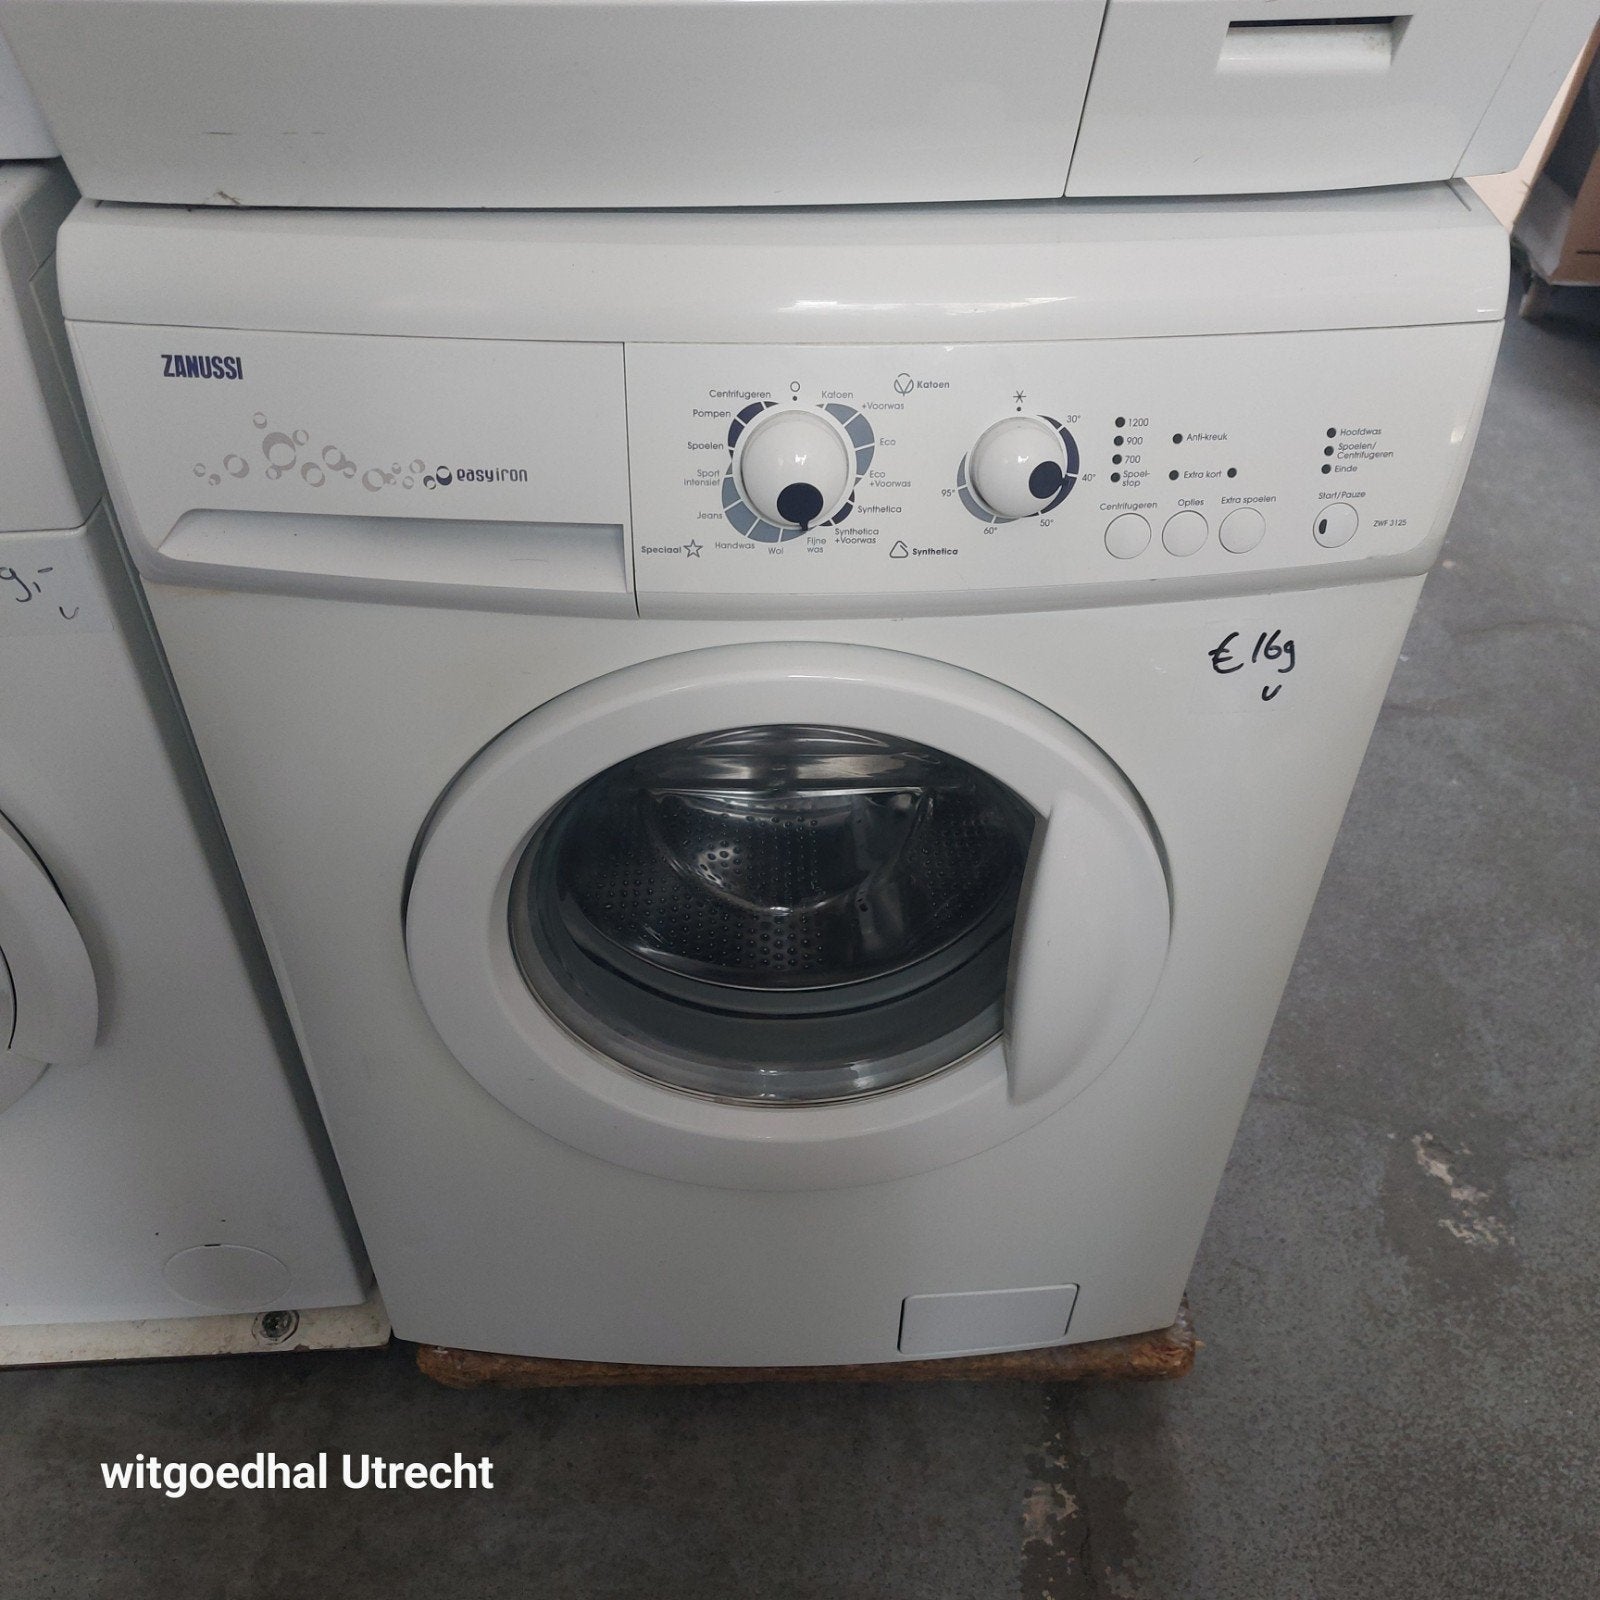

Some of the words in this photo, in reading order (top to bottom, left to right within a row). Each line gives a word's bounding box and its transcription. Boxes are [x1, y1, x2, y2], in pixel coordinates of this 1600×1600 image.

[161, 354, 244, 380] ZANUSSI
[917, 380, 950, 390] Katoen
[709, 390, 771, 400] Centrifugeren
[821, 391, 854, 399] Katoen
[862, 402, 905, 411] +Voorwas
[693, 410, 732, 420] Pompen
[1128, 418, 1149, 427] 1200
[1340, 428, 1382, 437] Hoofdwas
[1126, 436, 1144, 446] 900
[1187, 433, 1228, 442] Anti-kreuk
[687, 442, 724, 451] Spoelen
[880, 438, 896, 447] Eco
[1338, 442, 1377, 452] Spoelen/
[1125, 455, 1141, 464] 700
[1337, 450, 1394, 460] Centrifugeren
[1335, 465, 1358, 473] Einde
[456, 467, 529, 483] easyiron
[697, 470, 720, 479] Sport
[870, 471, 886, 479] Eco
[1123, 470, 1151, 479] Spoel-
[1184, 471, 1204, 479] Extra
[1206, 470, 1222, 479] kort
[870, 479, 912, 488] +Voorwas
[1122, 479, 1141, 488] stop
[1319, 490, 1366, 500] Start/Pauze
[1178, 498, 1204, 508] Opties
[1221, 497, 1242, 505] Extra
[1243, 495, 1277, 505] spoelen
[858, 505, 902, 515] Synthetica
[1100, 502, 1158, 511] Centrifugeren
[697, 512, 723, 520] Jeans
[835, 528, 880, 537] Synthetica
[807, 537, 827, 547] Fijne
[835, 536, 877, 545] +Voorwas
[715, 541, 756, 550] Handwas
[641, 545, 682, 556] Speciaal
[768, 547, 784, 555] Wol
[912, 547, 959, 557] Synthetica
